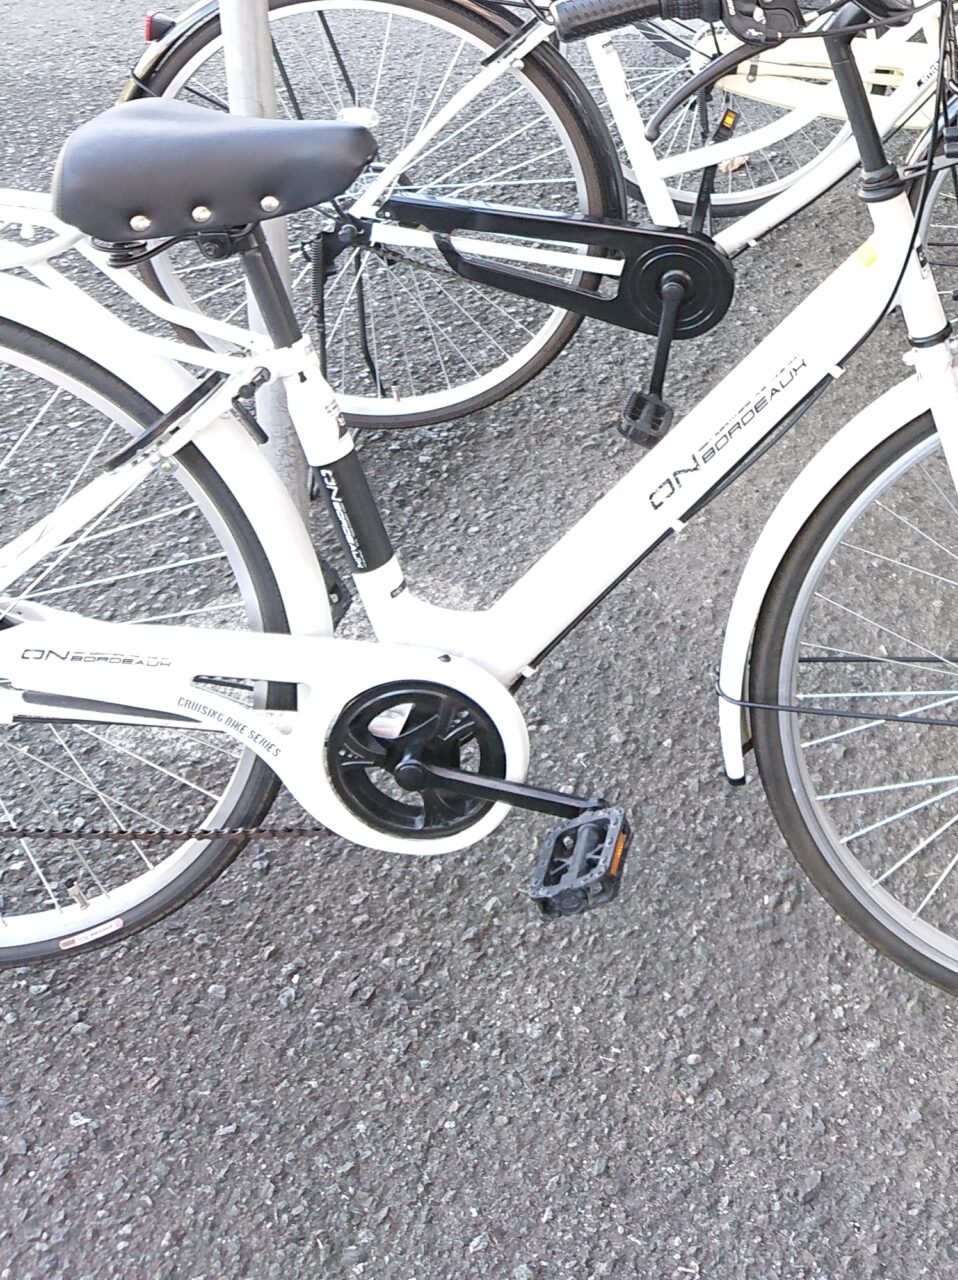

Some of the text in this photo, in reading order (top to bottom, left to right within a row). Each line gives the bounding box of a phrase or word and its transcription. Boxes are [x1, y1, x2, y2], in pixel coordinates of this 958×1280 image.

[177, 696, 282, 758] CRUISING BIKE SERIES
